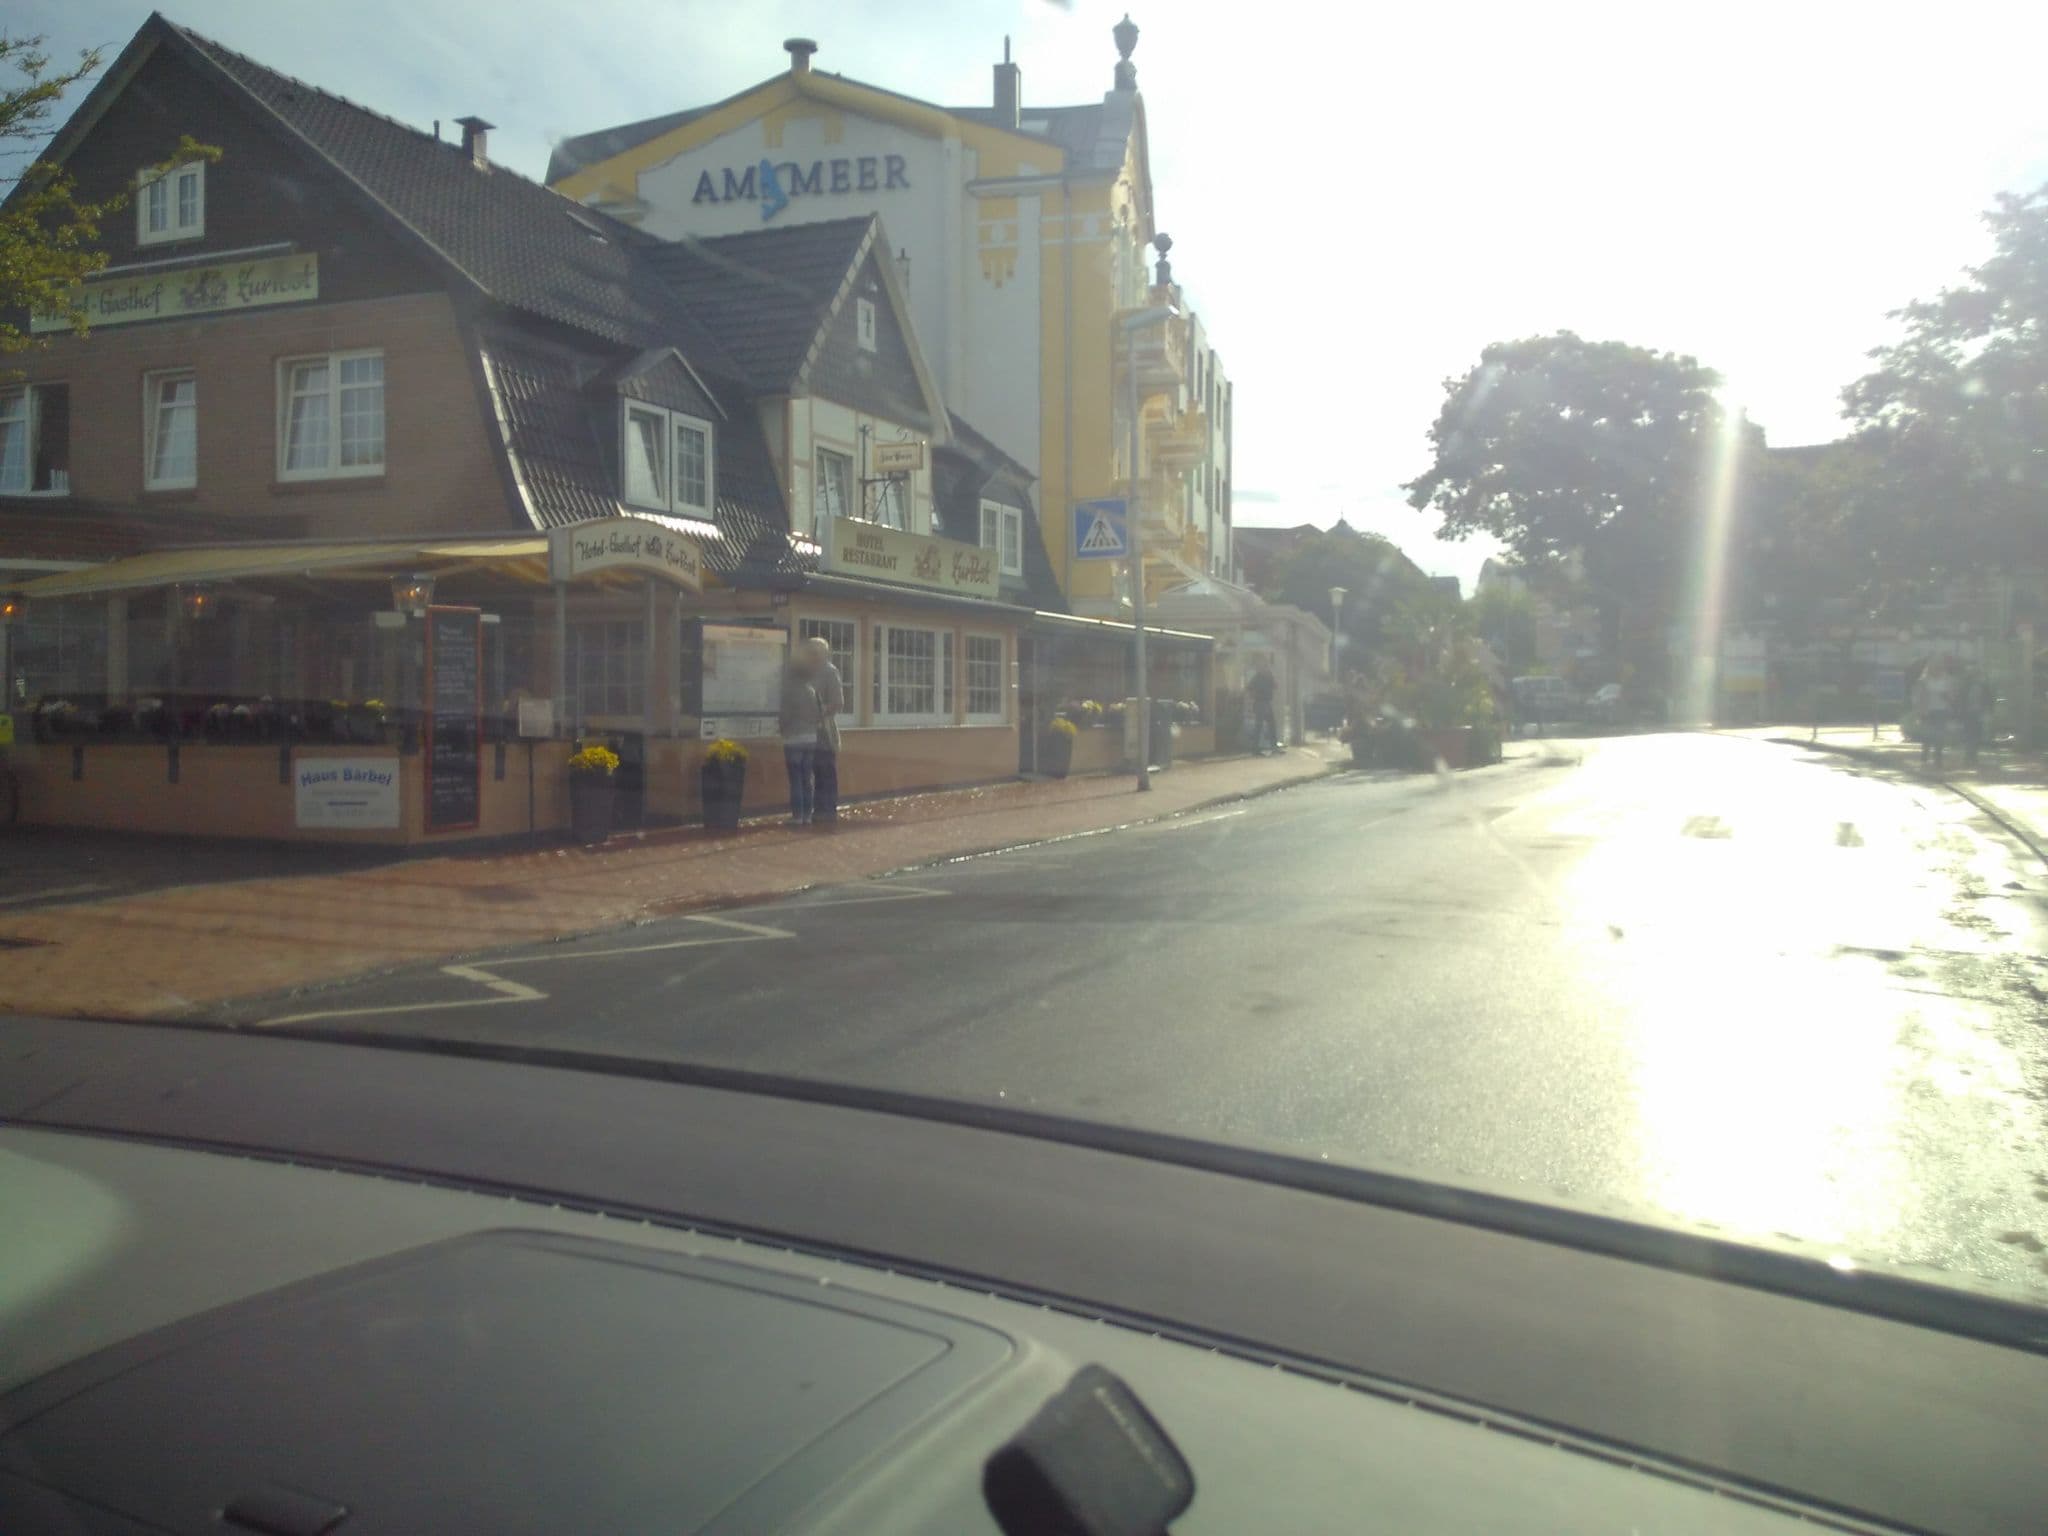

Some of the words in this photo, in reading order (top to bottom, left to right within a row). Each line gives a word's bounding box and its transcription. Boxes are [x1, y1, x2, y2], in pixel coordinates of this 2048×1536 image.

[692, 165, 757, 203] AM
[776, 154, 910, 197] MEER
[856, 531, 884, 553] HOTEL
[843, 546, 897, 571] RESTAURANT
[302, 770, 337, 787] Haus
